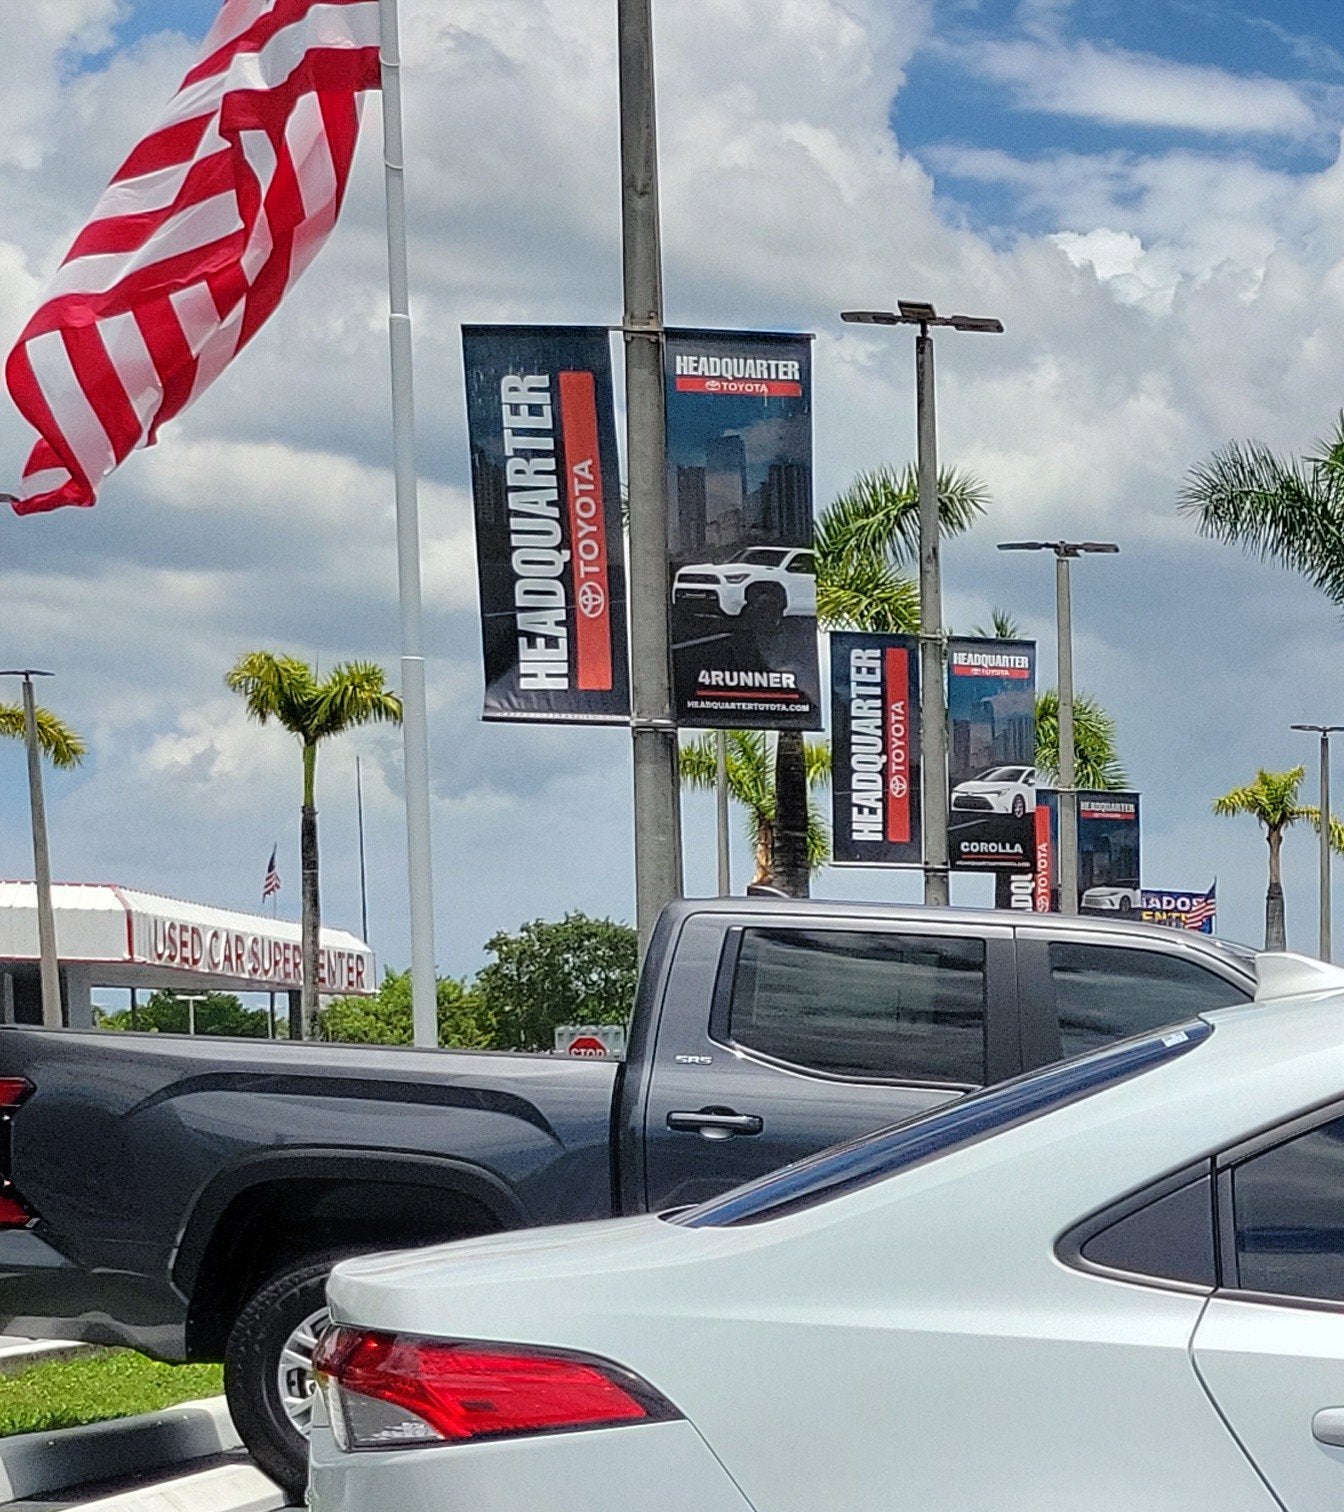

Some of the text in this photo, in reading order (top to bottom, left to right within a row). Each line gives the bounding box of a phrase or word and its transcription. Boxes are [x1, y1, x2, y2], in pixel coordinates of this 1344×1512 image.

[675, 355, 800, 381] HEADQUARTER
[721, 382, 768, 394] TOYOTA
[500, 372, 571, 691] HEADQUARTER
[572, 459, 602, 578] TOYOTA
[698, 670, 796, 688] 4RUNNER
[953, 652, 1029, 668] HEADQUARTER
[850, 648, 886, 841] HEADQUARTER
[890, 701, 909, 773] TOYOTA
[960, 841, 1023, 854] COROLLA
[1037, 842, 1048, 893] TOYOTA
[154, 919, 203, 966] USED
[209, 930, 245, 972] CAR
